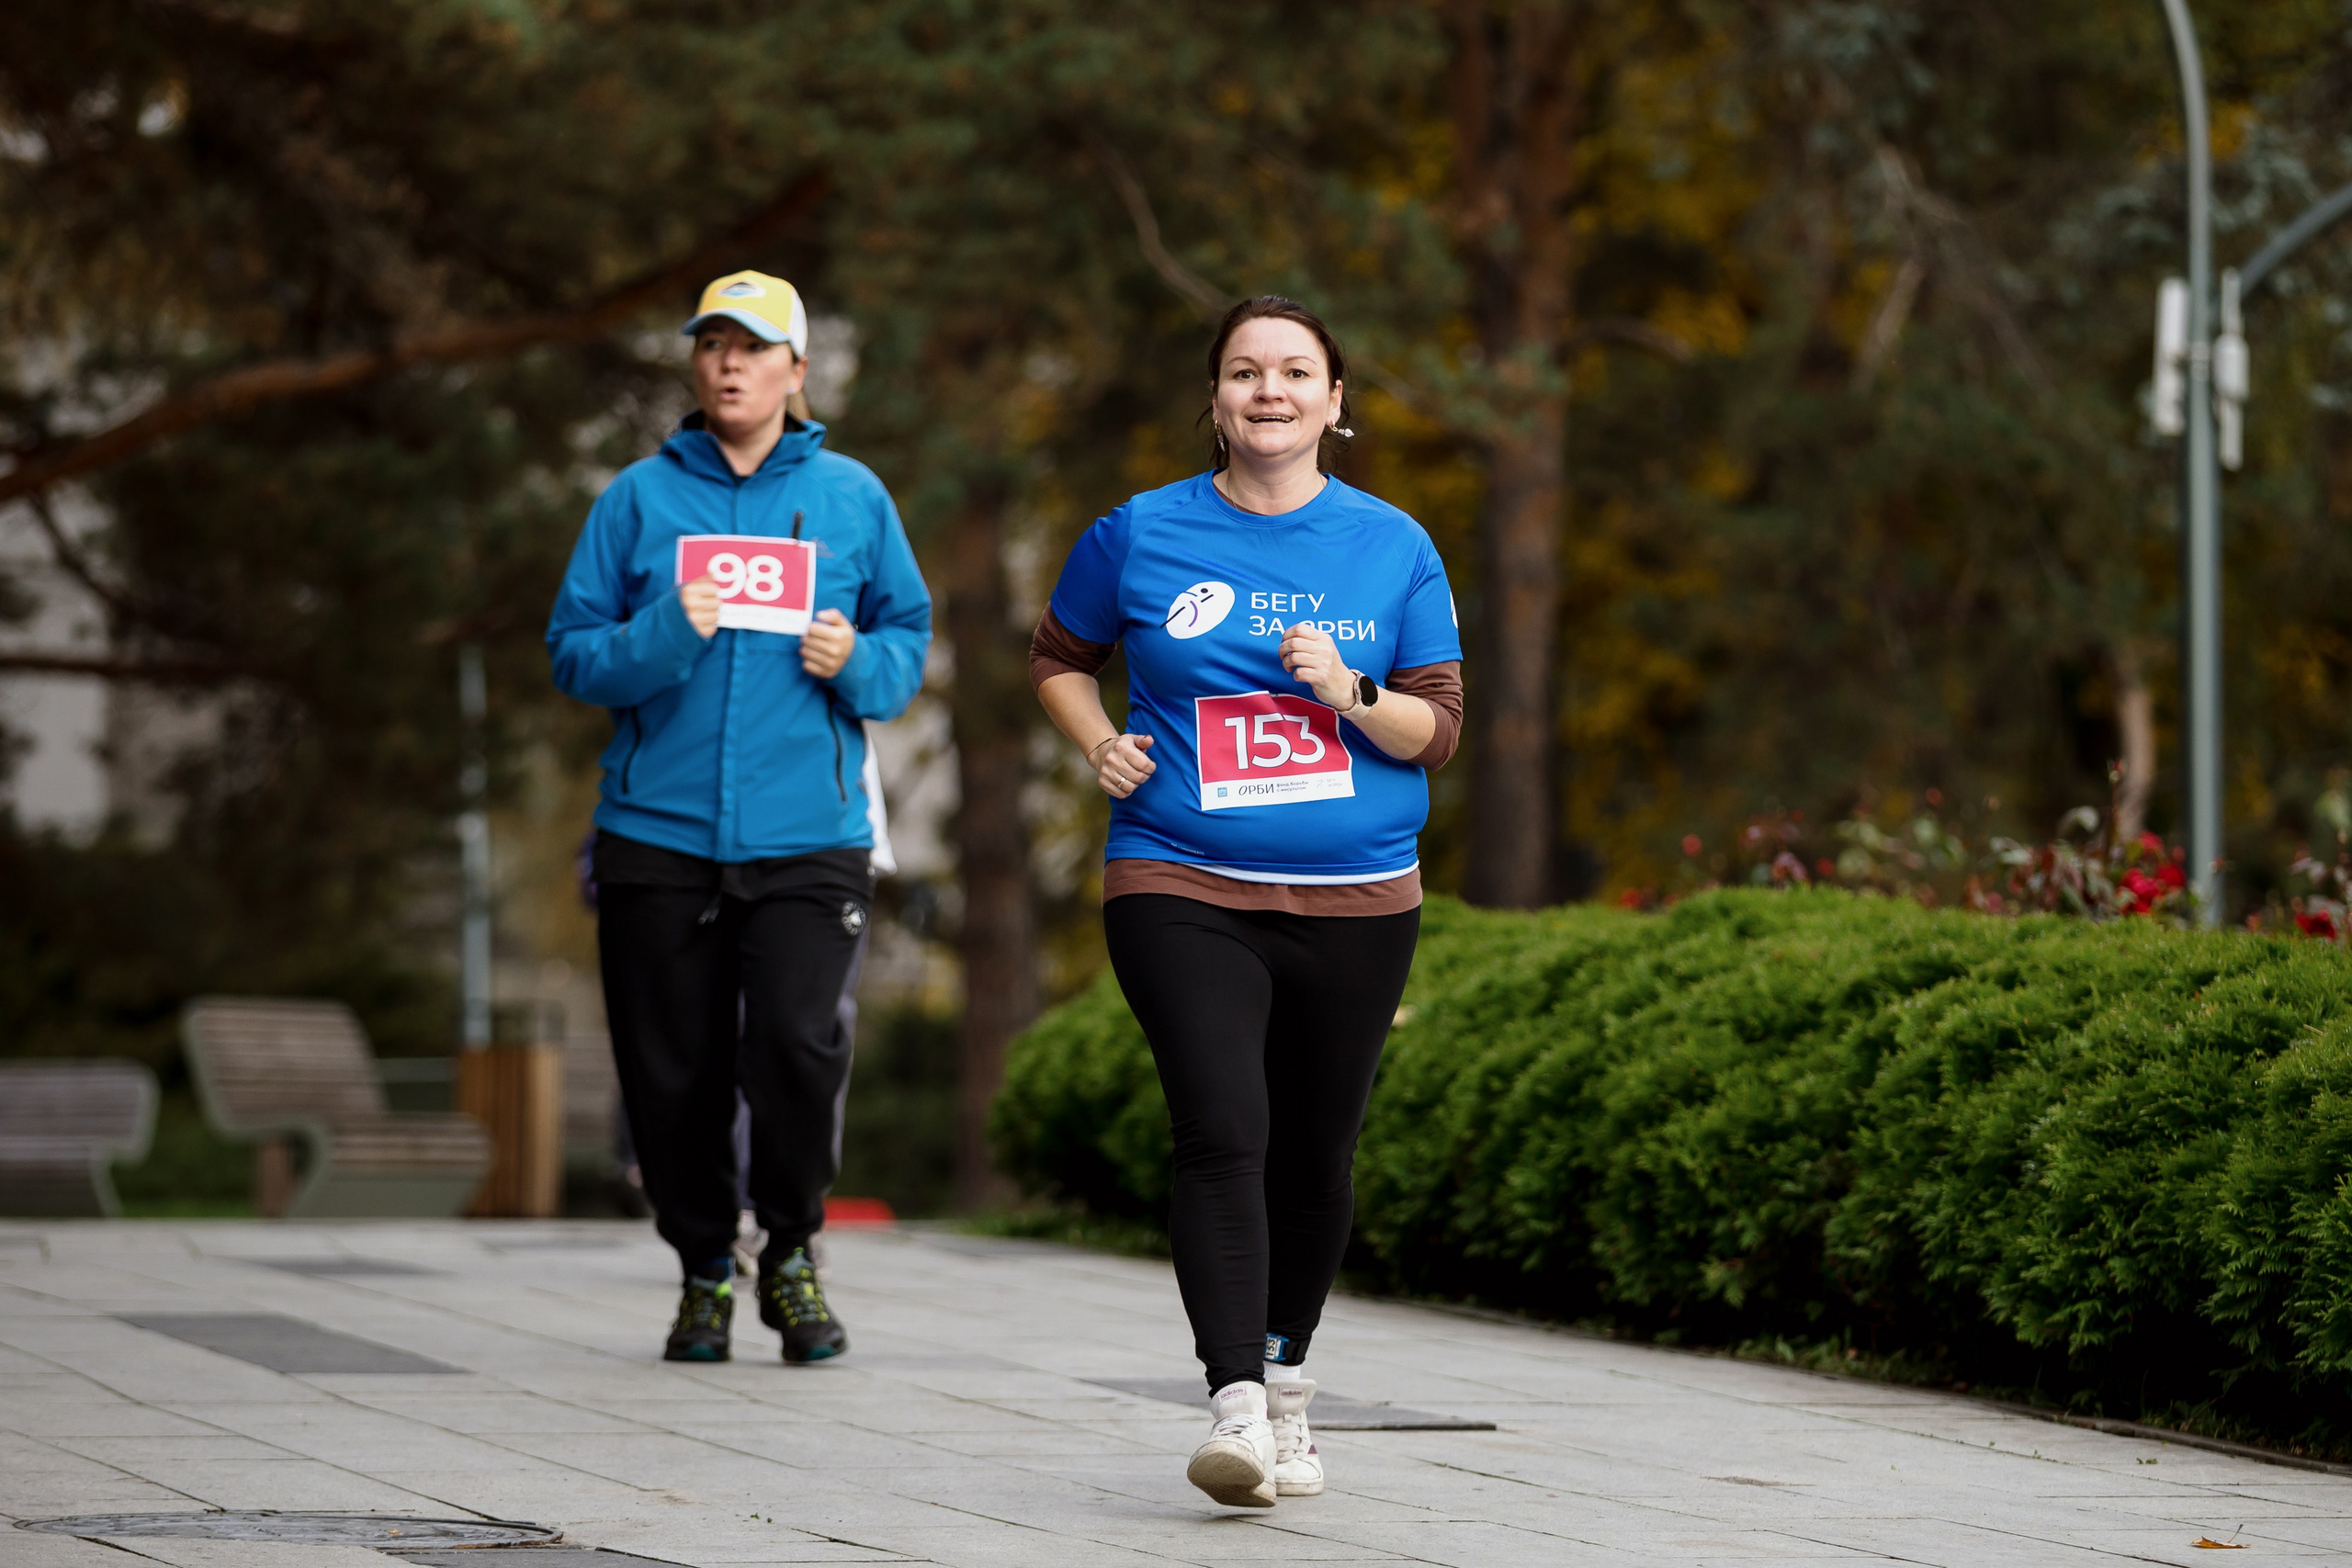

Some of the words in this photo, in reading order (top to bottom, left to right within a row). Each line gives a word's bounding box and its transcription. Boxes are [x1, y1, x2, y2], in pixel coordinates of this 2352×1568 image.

[707, 552, 785, 602] 98
[1250, 592, 1326, 613] БЕГУ
[1249, 615, 1285, 637] ЗА
[1224, 712, 1326, 771] 153
[1238, 784, 1274, 795] ОРБИ
[1266, 1338, 1275, 1356] 153
[1220, 1387, 1244, 1399] adidas
